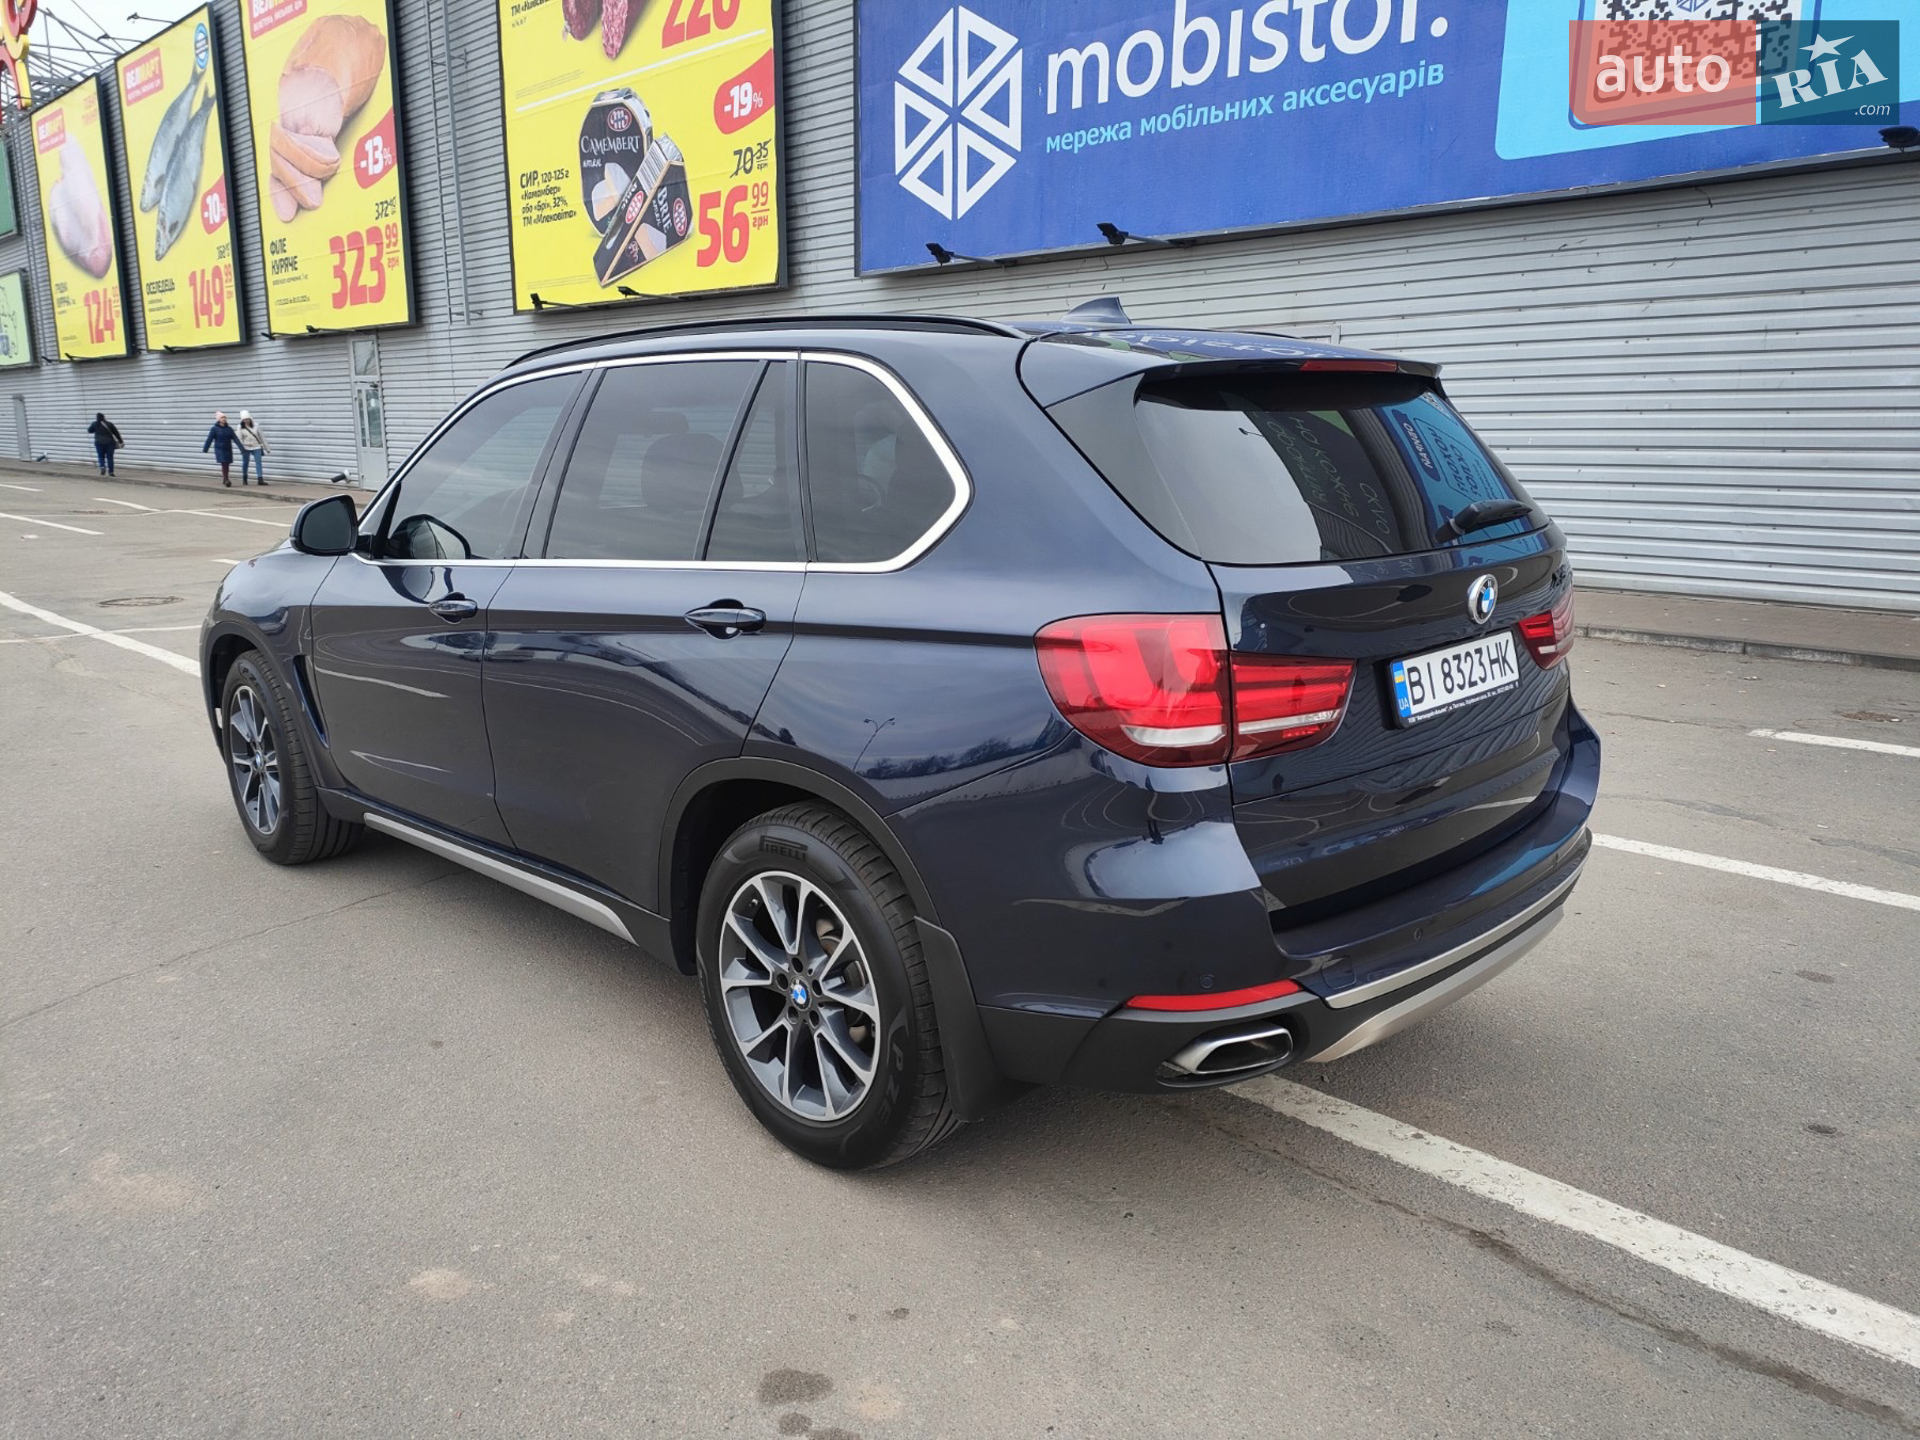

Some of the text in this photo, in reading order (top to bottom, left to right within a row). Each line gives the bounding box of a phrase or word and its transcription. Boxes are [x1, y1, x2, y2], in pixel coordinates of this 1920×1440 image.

[724, 82, 763, 119] -19%
[1045, 60, 1444, 154] мережа мобільних аксесуарів
[361, 136, 392, 175] -13%
[581, 135, 641, 155] CAMEMBERT
[520, 170, 540, 188] СИР,
[541, 168, 564, 184] 120-125
[697, 181, 769, 268] 56 99
[752, 215, 769, 231] грн
[329, 222, 398, 309] 323 99
[84, 288, 115, 345] 124
[188, 265, 225, 329] 149
[1407, 661, 1436, 706] BI
[1441, 646, 1488, 695] 8323
[1486, 639, 1515, 681] HK
[1399, 697, 1410, 710] UA
[760, 835, 808, 862] PIRELLI
